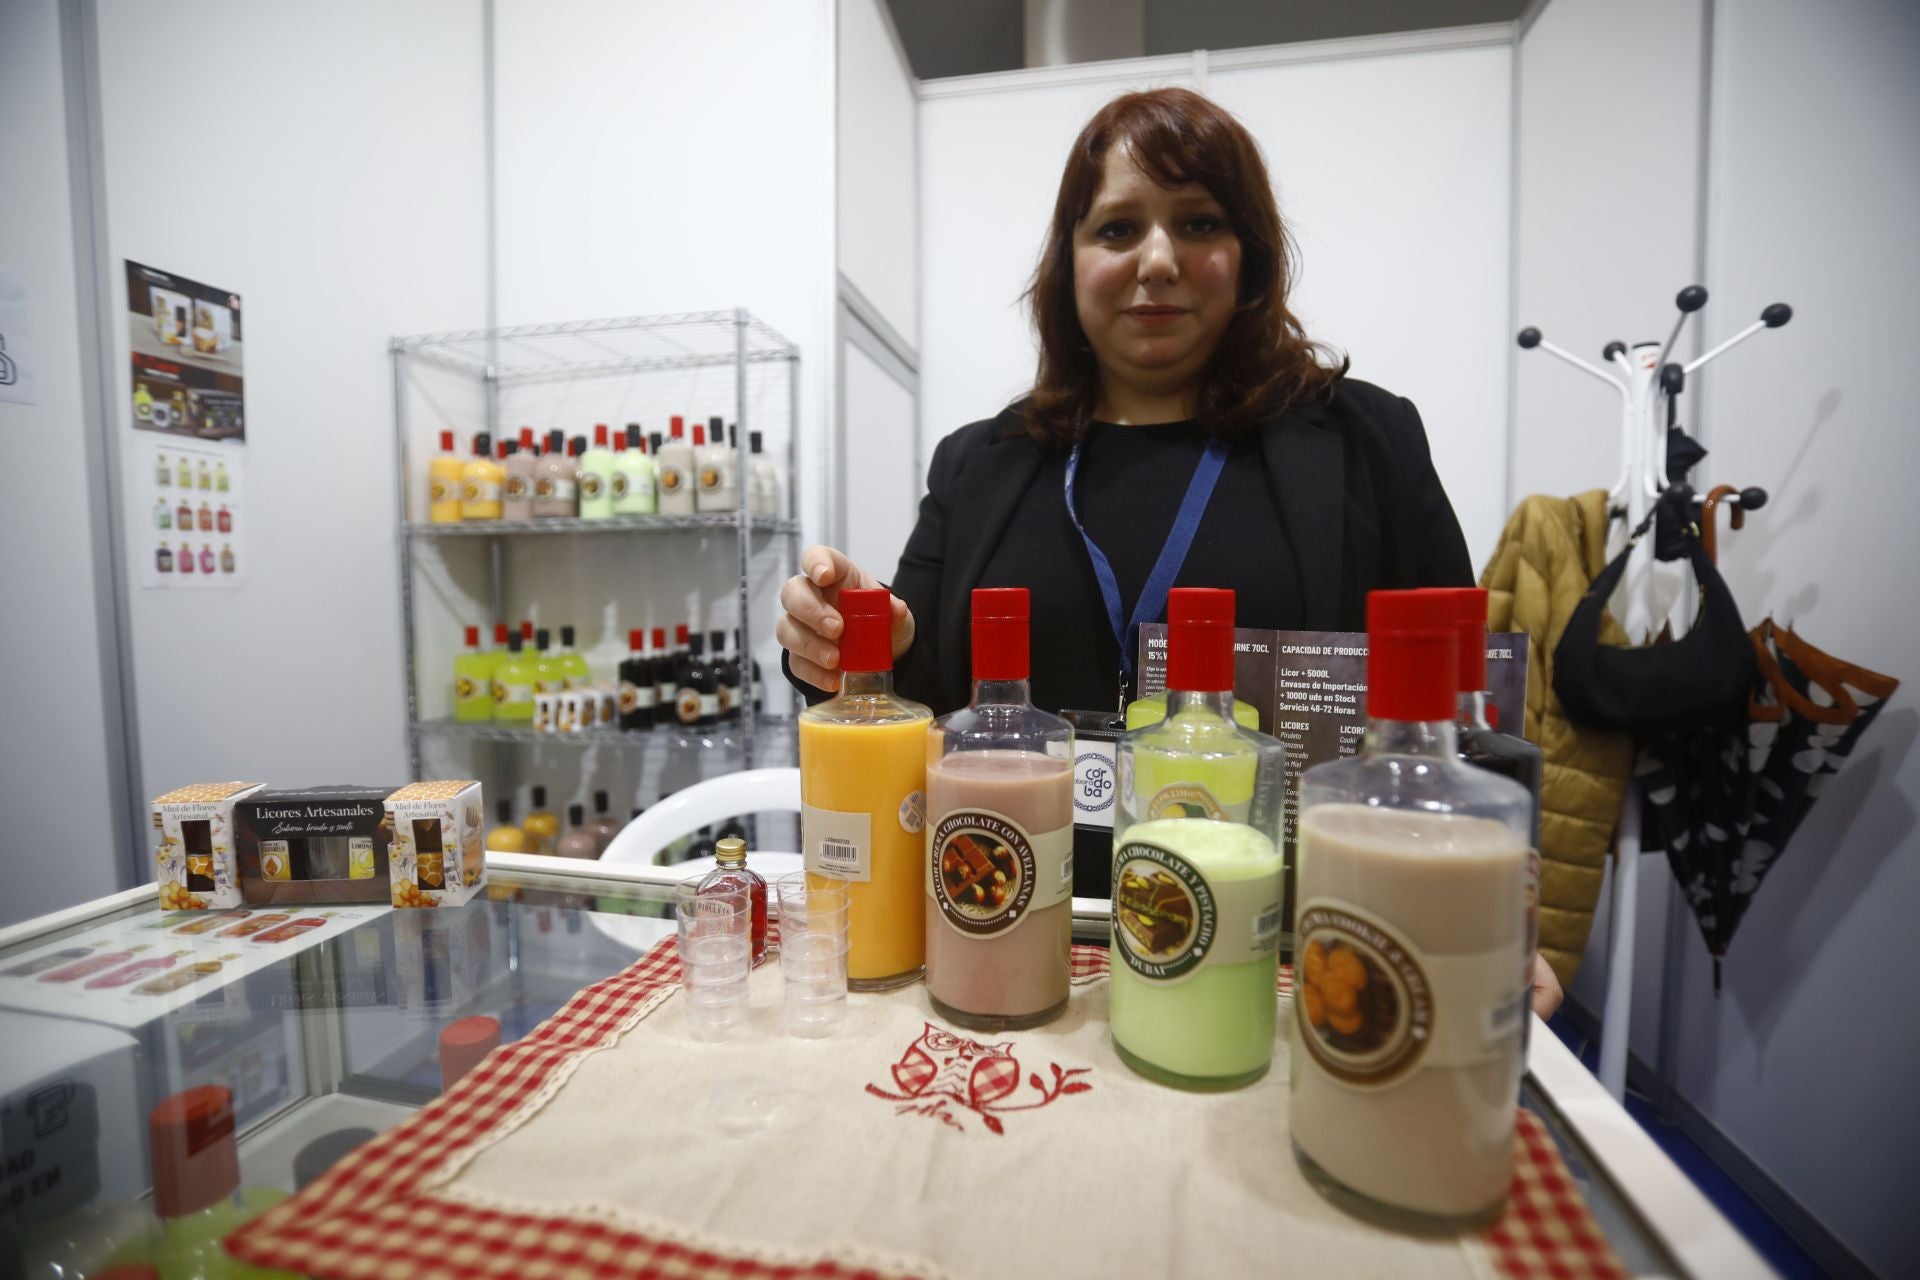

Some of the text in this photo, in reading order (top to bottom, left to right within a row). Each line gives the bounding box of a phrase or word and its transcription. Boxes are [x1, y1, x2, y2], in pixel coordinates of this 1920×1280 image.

[1148, 638, 1168, 648] MODE
[1252, 643, 1270, 653] 70CL
[1282, 645, 1321, 654] CAPACIDAD
[1322, 646, 1332, 655] DE
[1148, 650, 1162, 660] 15%
[1281, 668, 1300, 676] Licor
[1307, 669, 1330, 678] 5000L
[1280, 680, 1368, 692] Envases de Importación
[1286, 692, 1308, 700] 10000
[1308, 692, 1322, 701] uds
[1334, 694, 1356, 703] Stock
[1280, 702, 1356, 715] Servicio 48-72 Horas
[1280, 721, 1310, 730] LICORES
[162, 805, 181, 813] Miel
[192, 804, 217, 812] Flores
[256, 804, 374, 819] Licores Artesanales
[944, 816, 1000, 834] CHOCOLATE
[1000, 826, 1022, 845] CON
[933, 832, 945, 865] CREMA
[1016, 844, 1033, 907] AVELLANAS
[932, 870, 944, 900] LICOR
[1128, 846, 1191, 877] CHOCOLATE
[1188, 874, 1198, 885] Y
[1194, 884, 1214, 946] PISTACHO
[698, 902, 730, 915] PIRULETA
[1129, 956, 1166, 976] DUBAI
